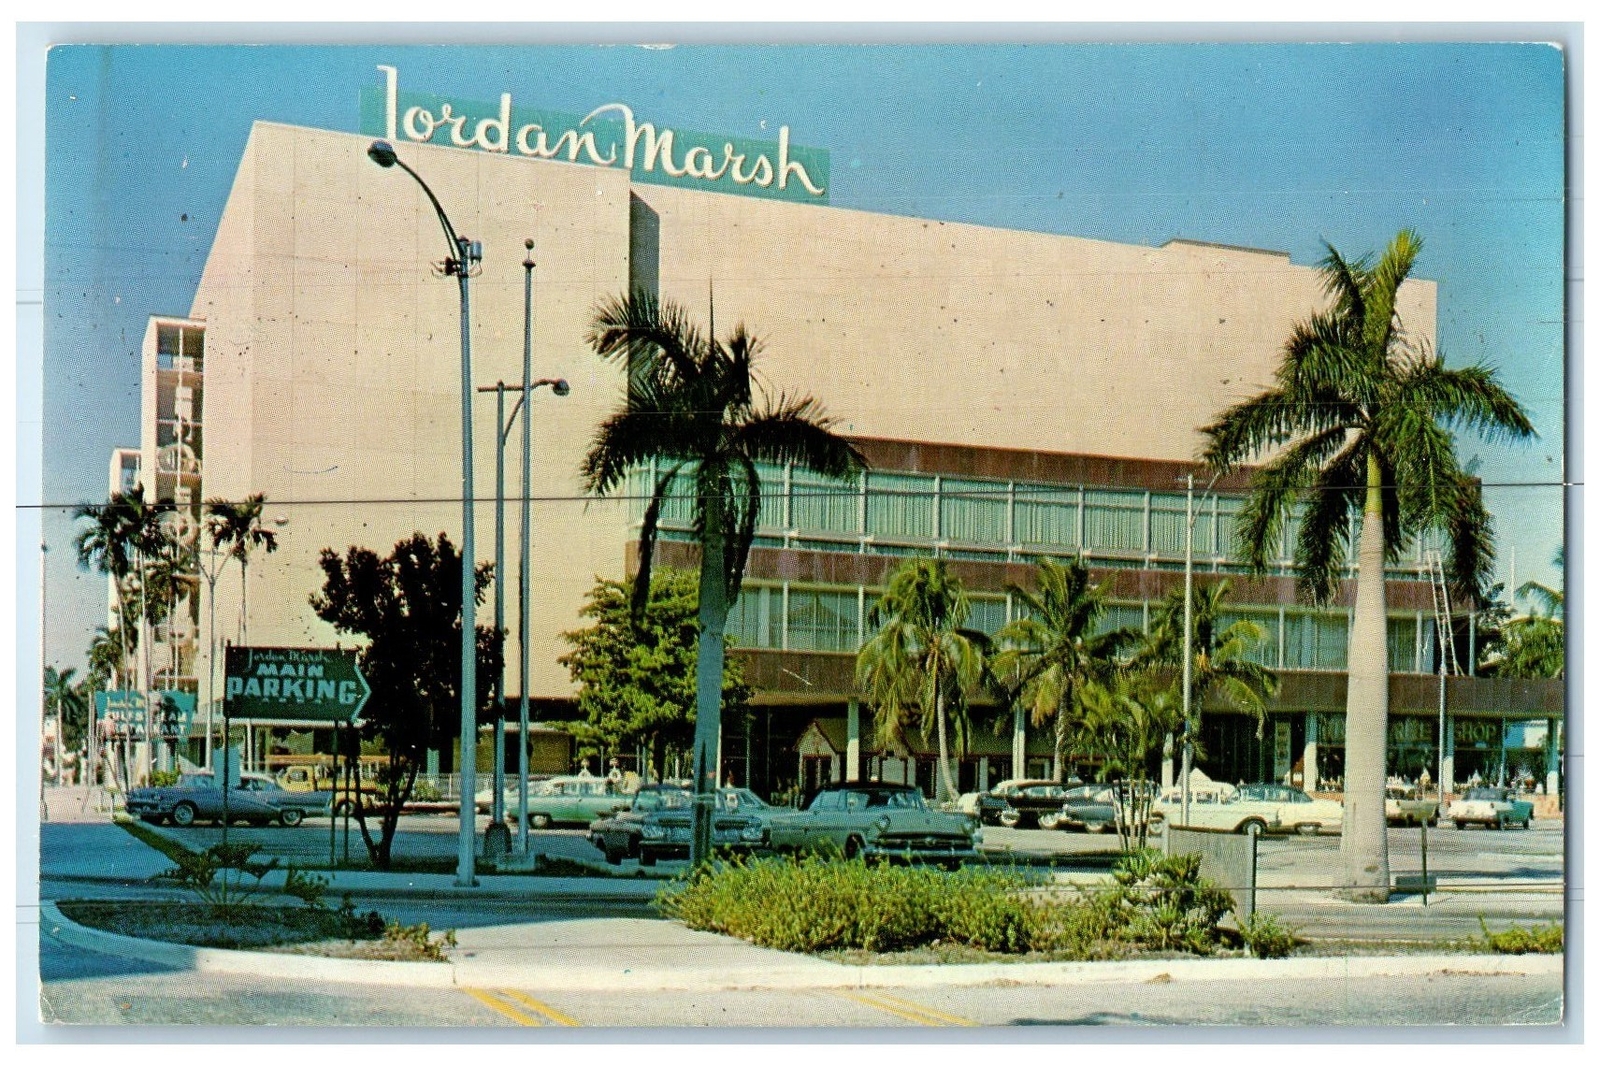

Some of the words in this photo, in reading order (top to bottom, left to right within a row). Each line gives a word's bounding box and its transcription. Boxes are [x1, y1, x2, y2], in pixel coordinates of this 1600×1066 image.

[377, 65, 617, 168] Jordan
[580, 103, 825, 195] Marsh
[257, 662, 324, 678] MAIN
[226, 676, 357, 704] PARKING
